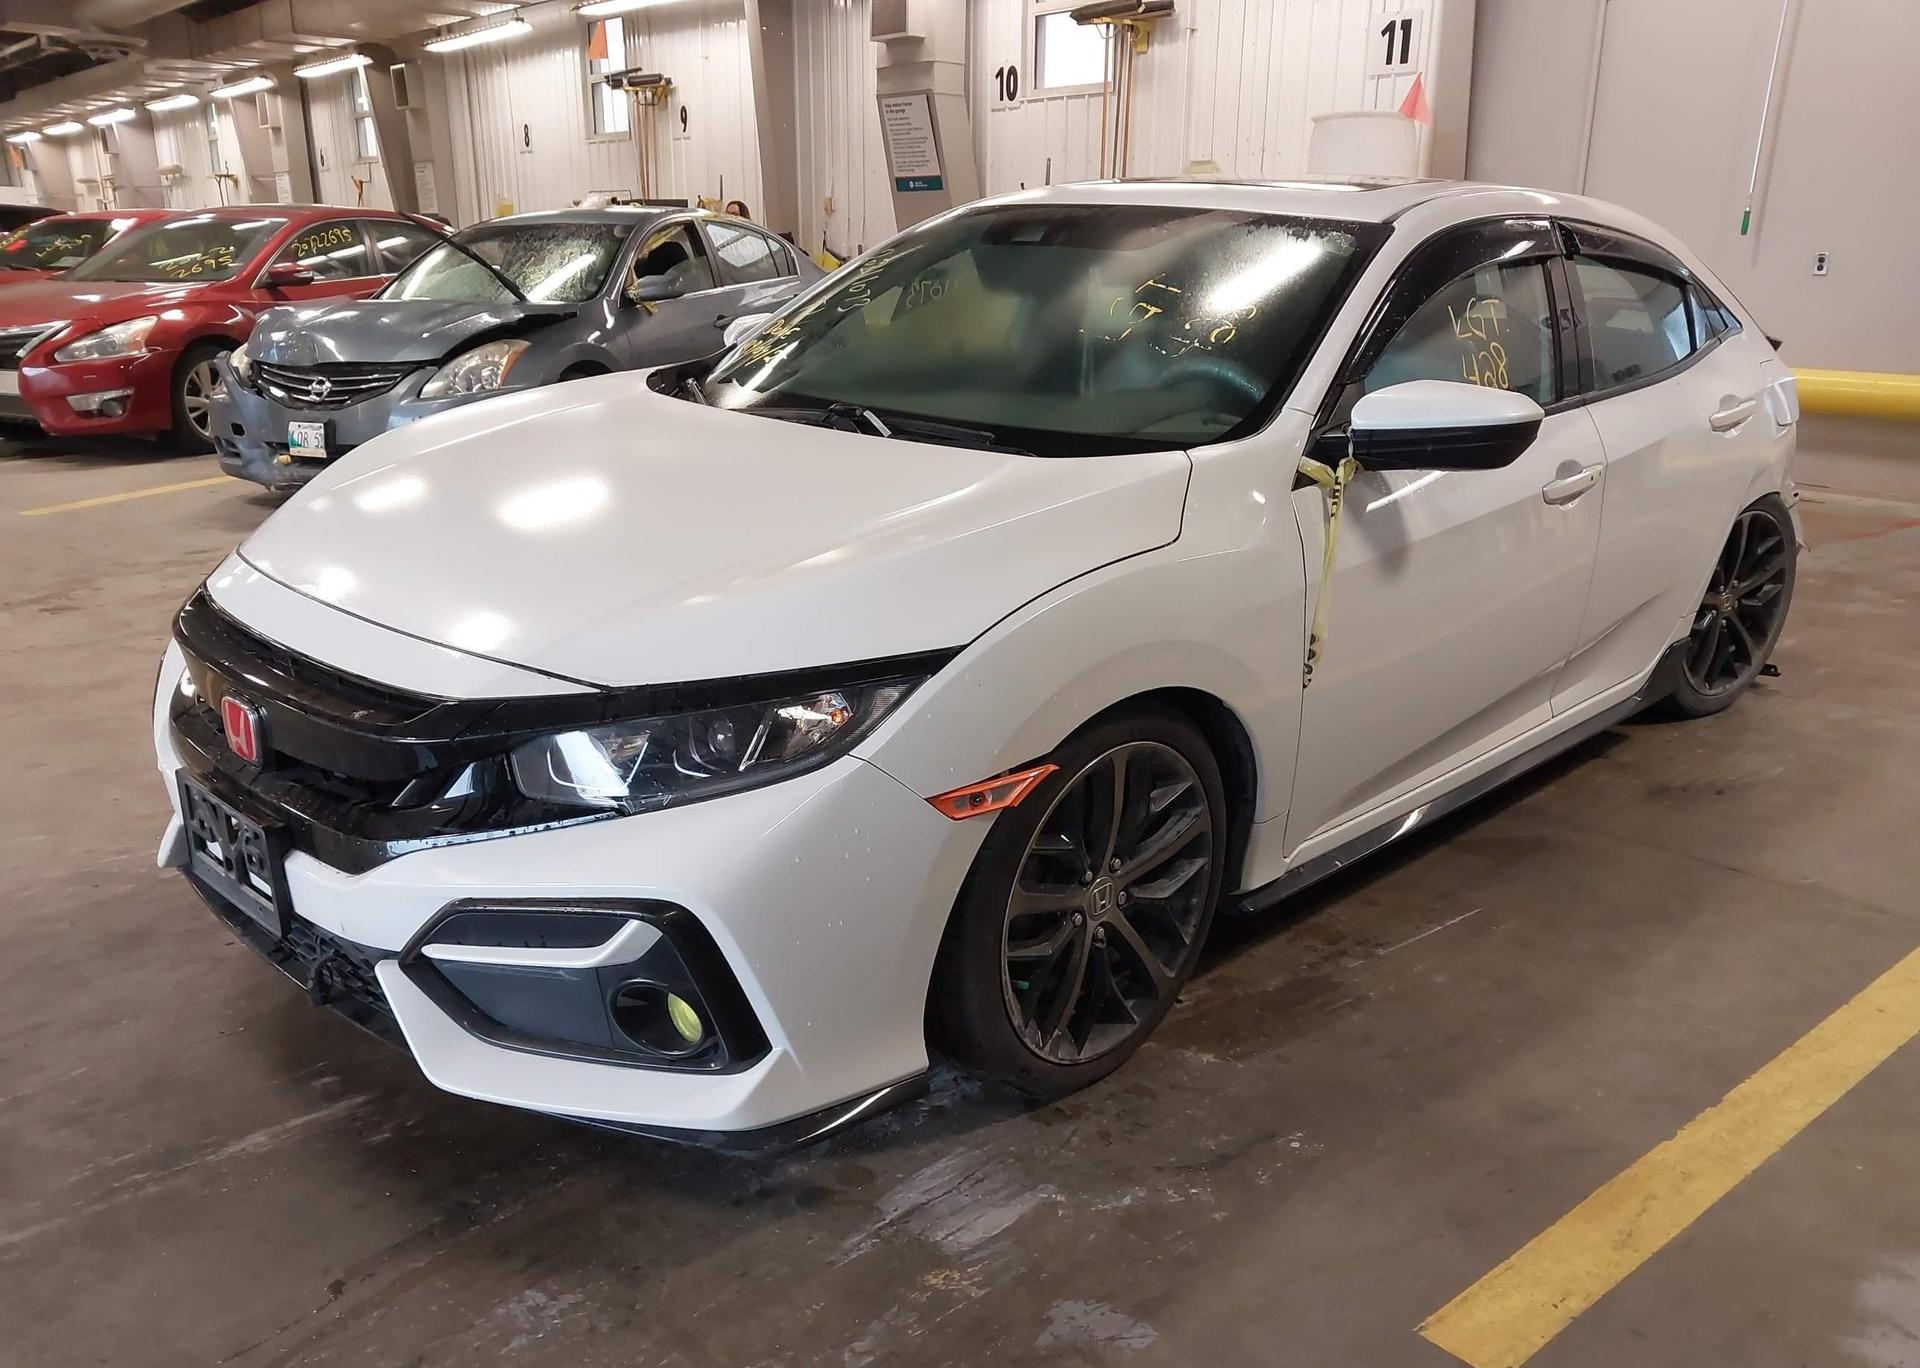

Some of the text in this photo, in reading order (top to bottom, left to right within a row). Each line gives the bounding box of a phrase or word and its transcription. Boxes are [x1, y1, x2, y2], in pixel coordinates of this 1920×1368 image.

[1381, 18, 1412, 65] 11
[995, 65, 1018, 102] 10
[680, 105, 687, 133] 9
[523, 123, 530, 148] 8
[320, 148, 325, 167] 6
[171, 255, 233, 279] 2695
[1461, 342, 1509, 388] 428
